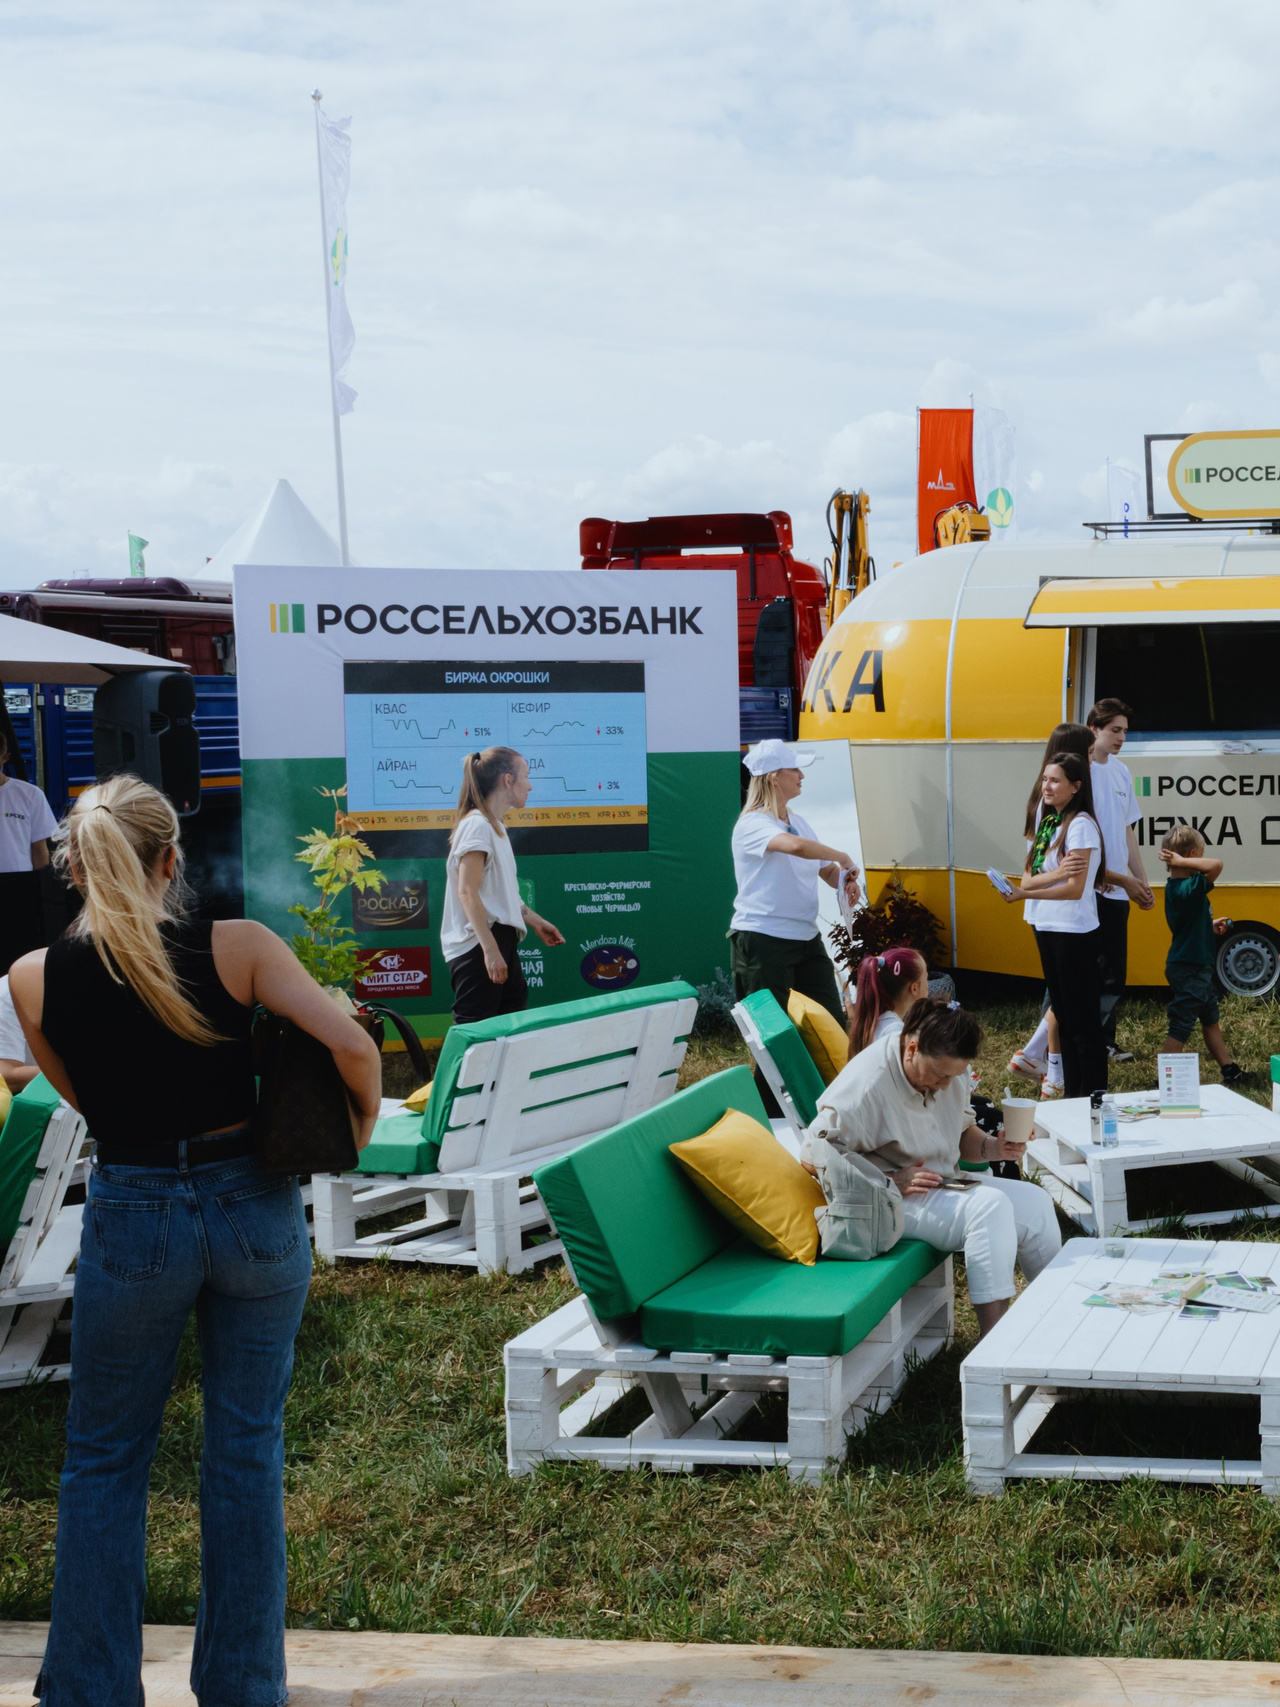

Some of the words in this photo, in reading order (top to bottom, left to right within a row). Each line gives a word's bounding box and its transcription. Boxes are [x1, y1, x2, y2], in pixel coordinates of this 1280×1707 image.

[317, 603, 704, 635] РОССЕЛЬХОЗБАНК
[445, 671, 487, 684] БИРЖА
[490, 671, 550, 684] ОКРОШКИ
[375, 703, 408, 715] КВАС
[511, 702, 551, 713] КЕФИР
[474, 727, 491, 737] 51%
[605, 725, 624, 735] 33%
[377, 758, 417, 771] АЙРАН
[526, 758, 545, 771] ДА
[606, 781, 620, 790] 3%
[394, 815, 409, 823] KVS
[518, 812, 534, 820] VOD
[540, 812, 550, 820] 3%
[557, 811, 571, 819] KVS
[597, 810, 611, 818] KFR
[617, 810, 631, 818] 33%
[357, 896, 420, 911] РОСКАР
[580, 934, 617, 953] Mendoza
[366, 973, 390, 984] МИТ
[393, 971, 420, 983] СТАР
